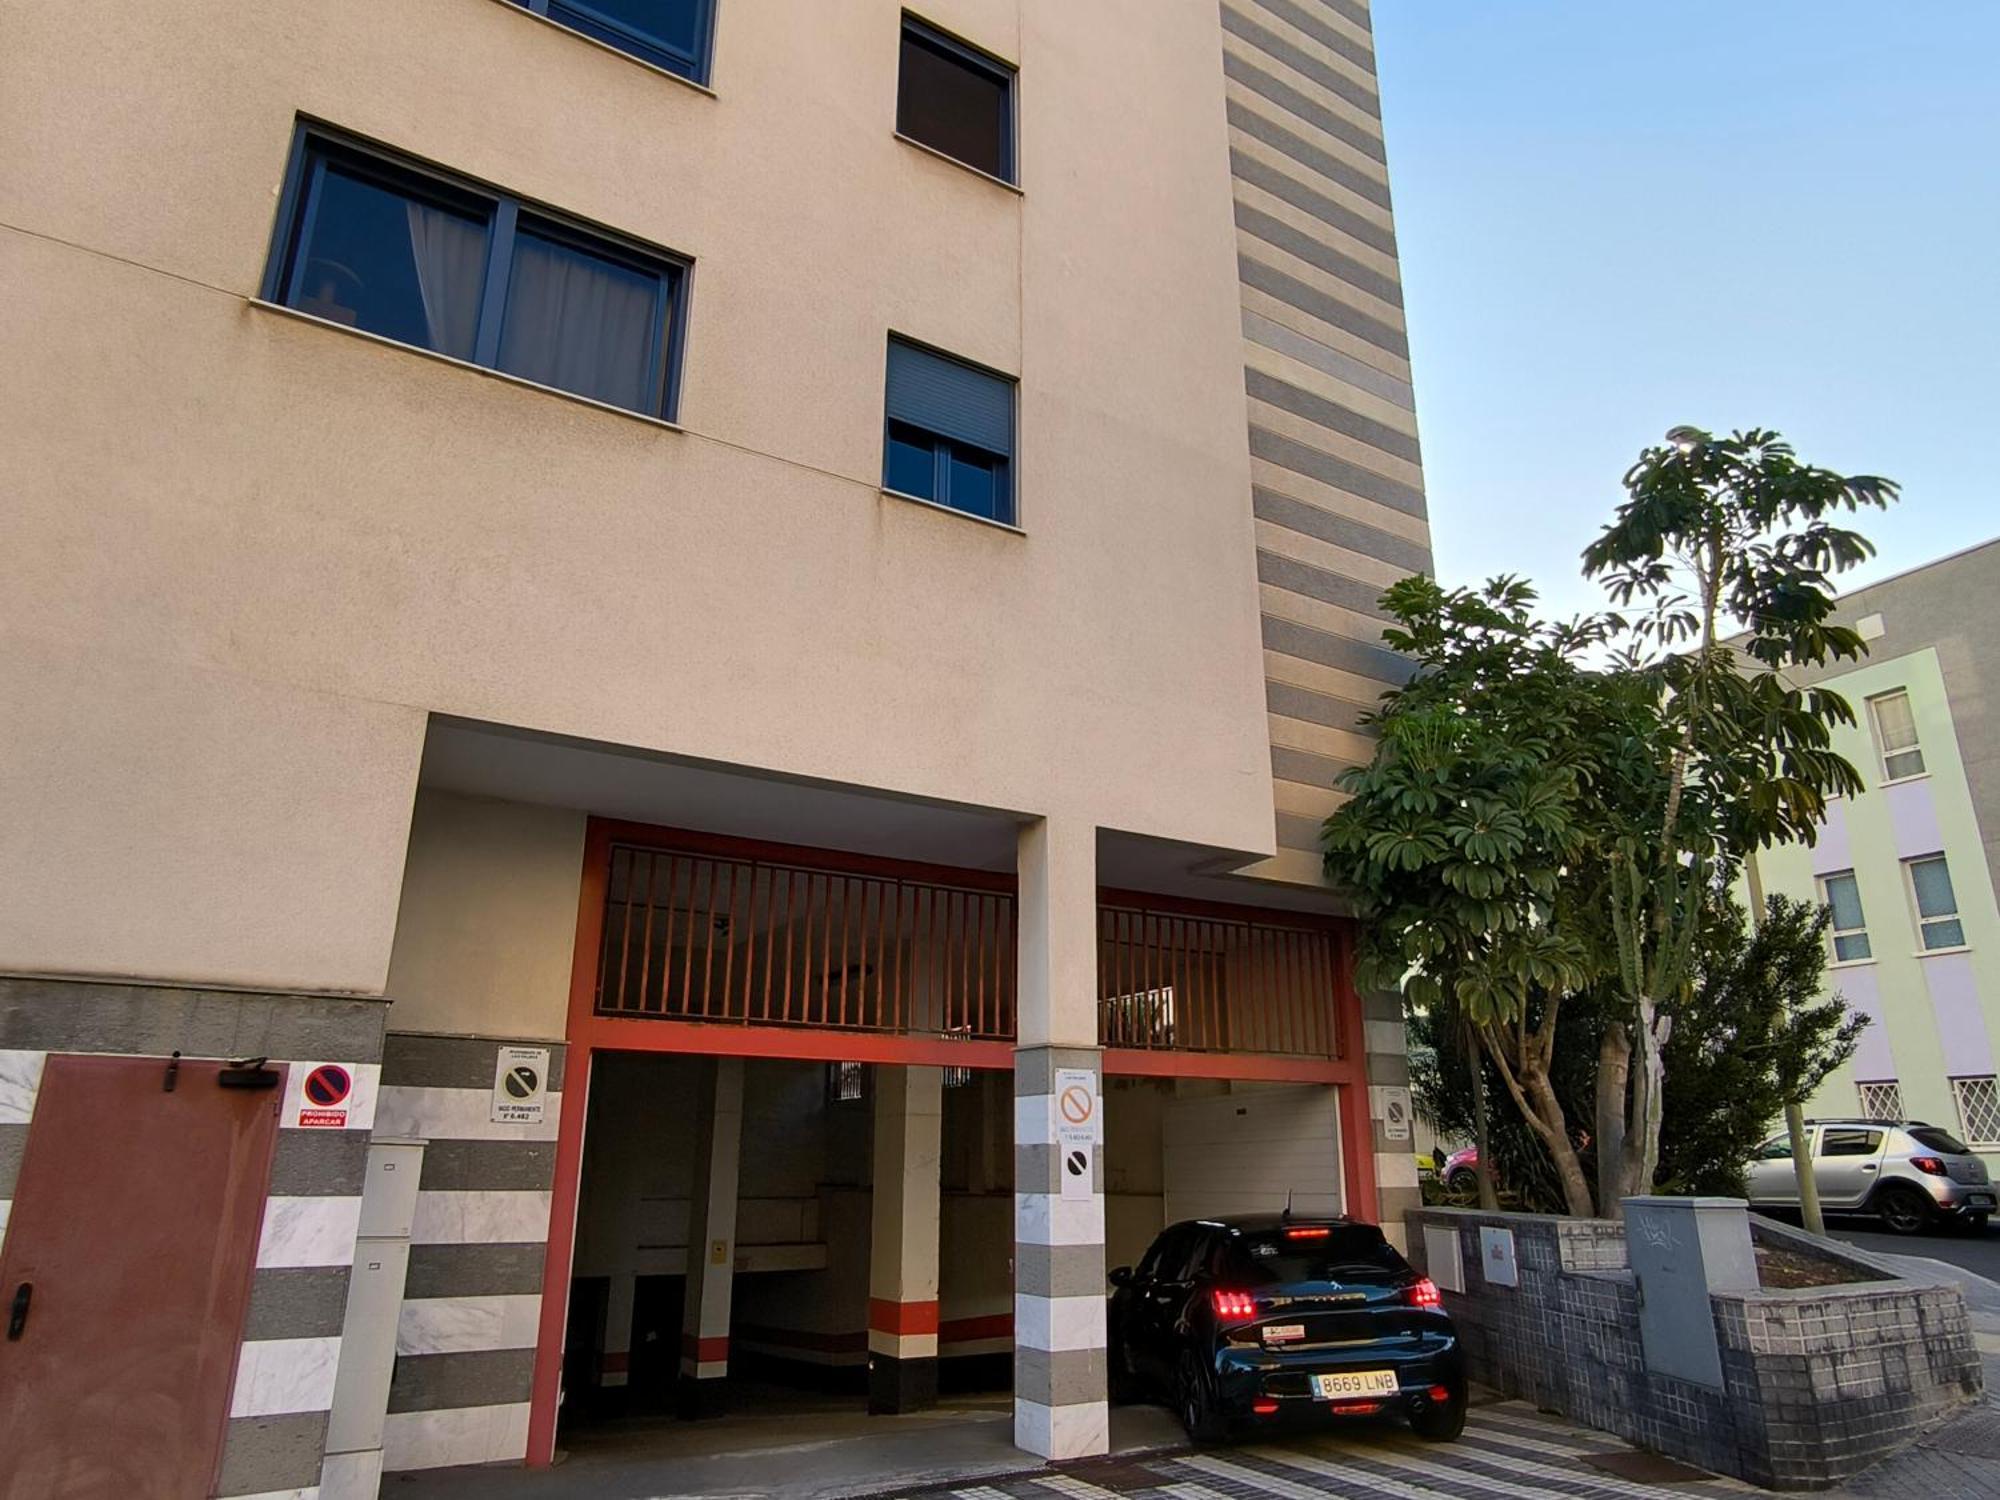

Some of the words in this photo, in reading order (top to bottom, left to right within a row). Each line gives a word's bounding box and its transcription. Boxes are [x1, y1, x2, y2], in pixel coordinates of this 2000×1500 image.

[302, 1110, 345, 1118] PROHIBIDO
[1323, 1376, 1361, 1393] 8669
[1364, 1374, 1394, 1390] LNB
